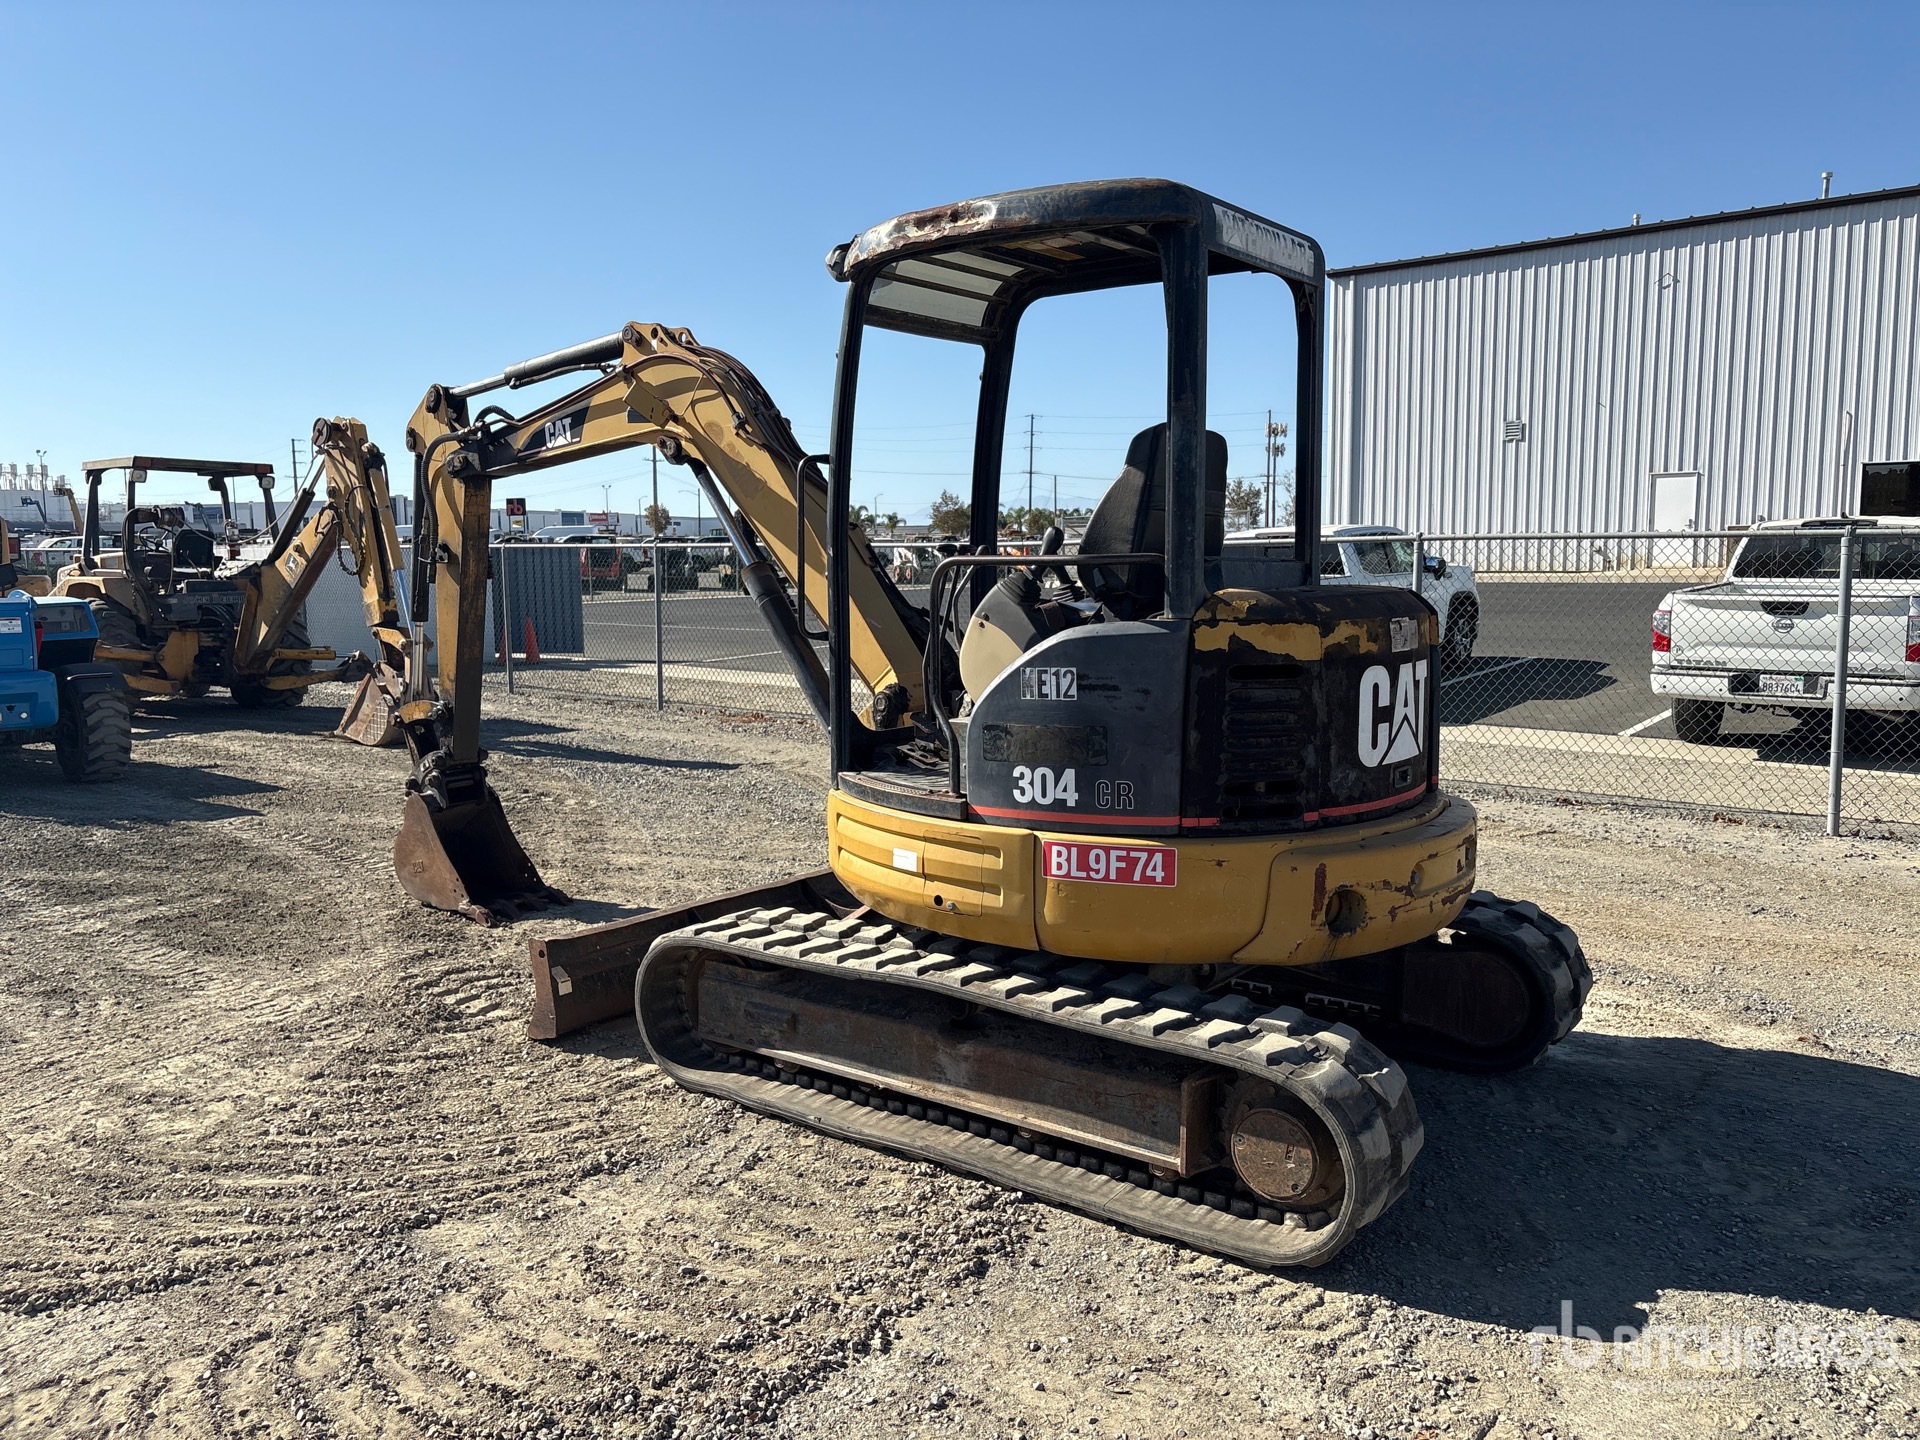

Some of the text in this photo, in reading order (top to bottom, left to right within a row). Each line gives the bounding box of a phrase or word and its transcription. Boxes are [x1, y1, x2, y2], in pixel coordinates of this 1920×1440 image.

[544, 417, 572, 449] CAT
[507, 500, 524, 516] rb
[1358, 660, 1427, 768] CAT
[1012, 765, 1134, 810] 304 CR
[1051, 845, 1165, 882] BL9F74
